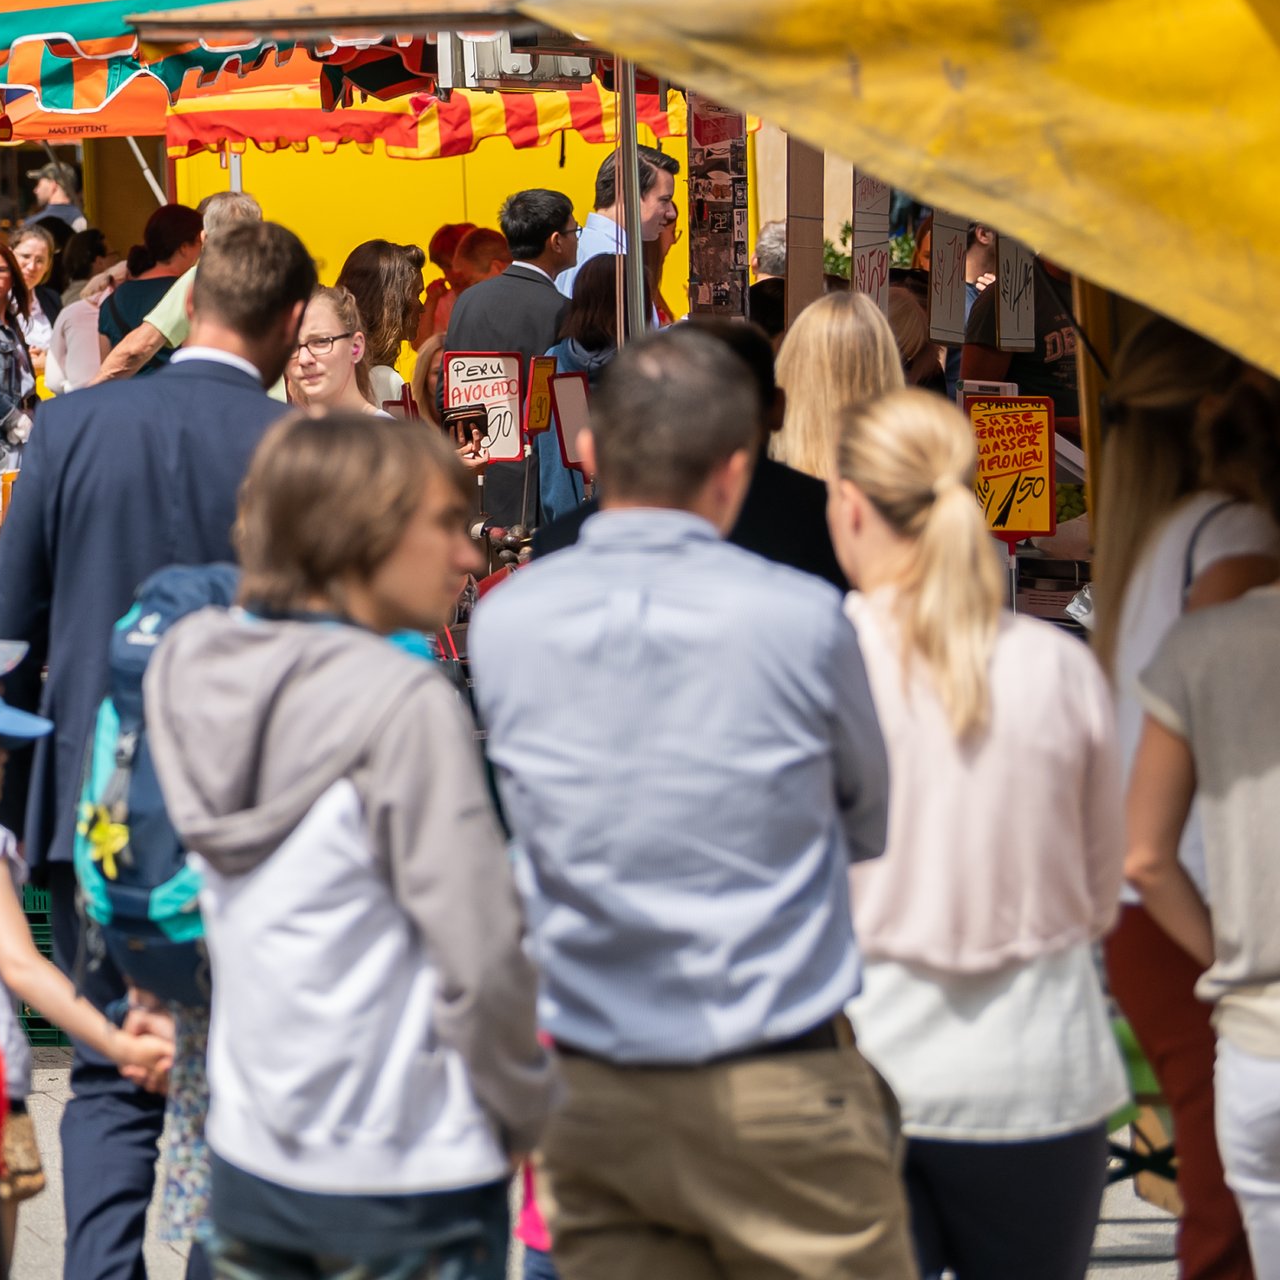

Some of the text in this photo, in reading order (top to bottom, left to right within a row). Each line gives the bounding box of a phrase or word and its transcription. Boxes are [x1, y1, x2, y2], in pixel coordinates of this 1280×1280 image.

[48, 124, 108, 135] MASTERTENT
[452, 360, 504, 378] PERU
[451, 379, 518, 406] AVOCADO
[978, 434, 1040, 455] WASSER
